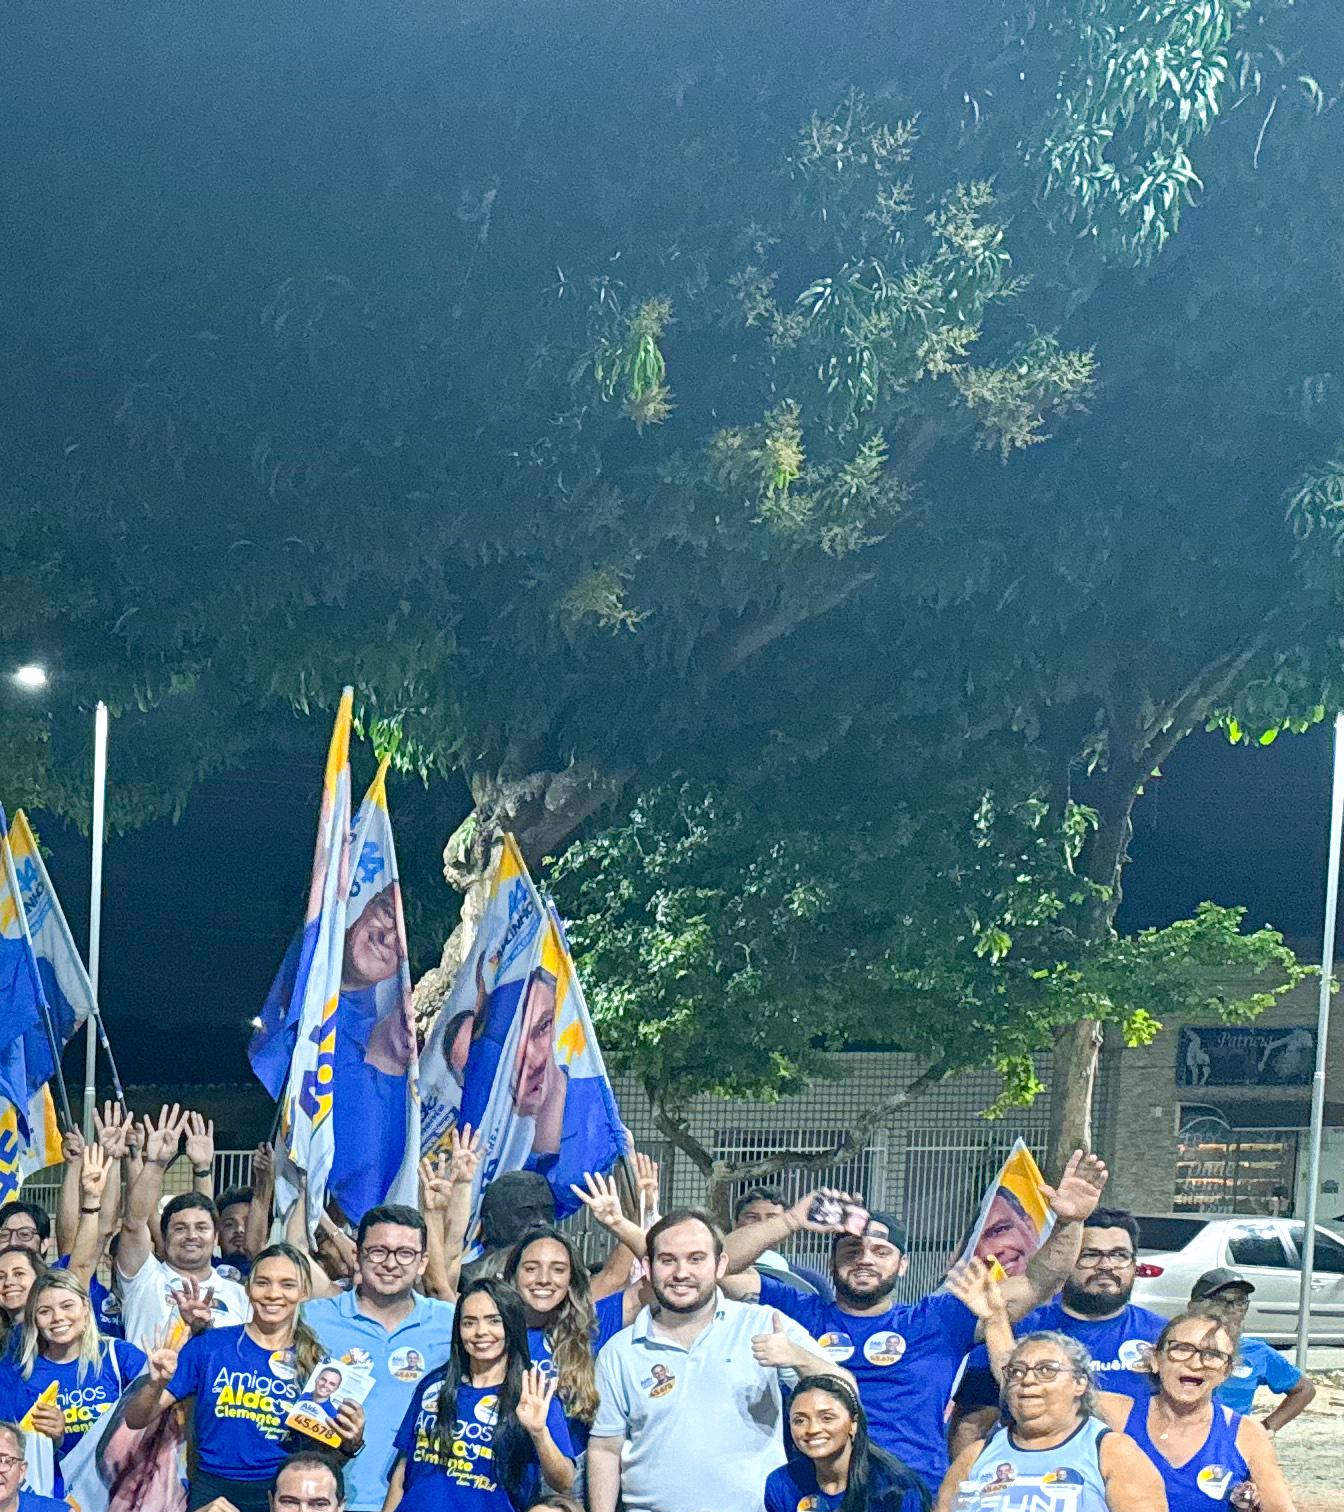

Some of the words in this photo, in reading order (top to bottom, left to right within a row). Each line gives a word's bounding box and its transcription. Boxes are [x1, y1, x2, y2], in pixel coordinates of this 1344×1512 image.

[213, 1366, 297, 1399] Amigos
[215, 1384, 278, 1413] Aldo
[214, 1405, 282, 1427] Clemente
[293, 1413, 338, 1441] 45.678
